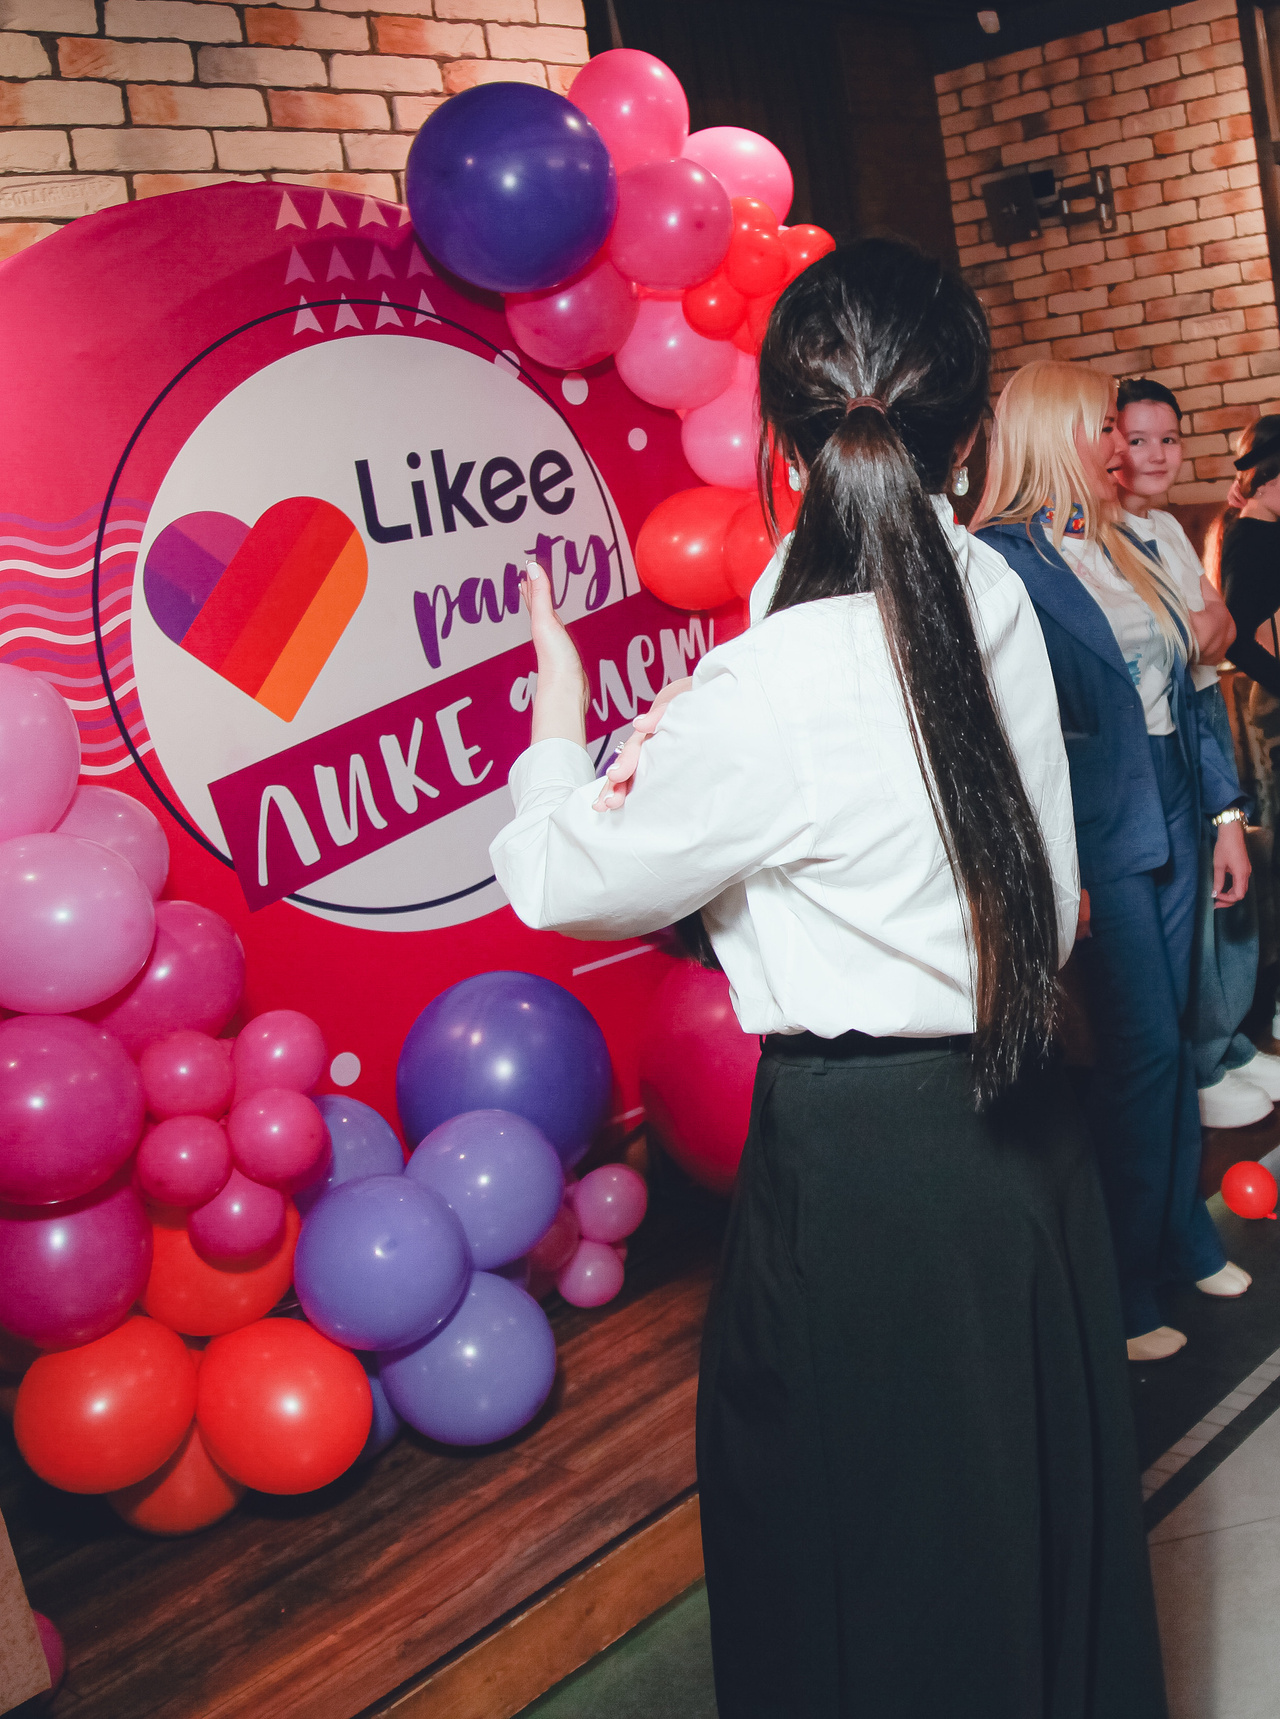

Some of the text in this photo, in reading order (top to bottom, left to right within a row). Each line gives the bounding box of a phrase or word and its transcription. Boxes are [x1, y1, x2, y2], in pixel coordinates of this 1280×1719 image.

[355, 448, 576, 545] Likee
[413, 532, 618, 669] party
[257, 696, 494, 887] ЛИКЕ
